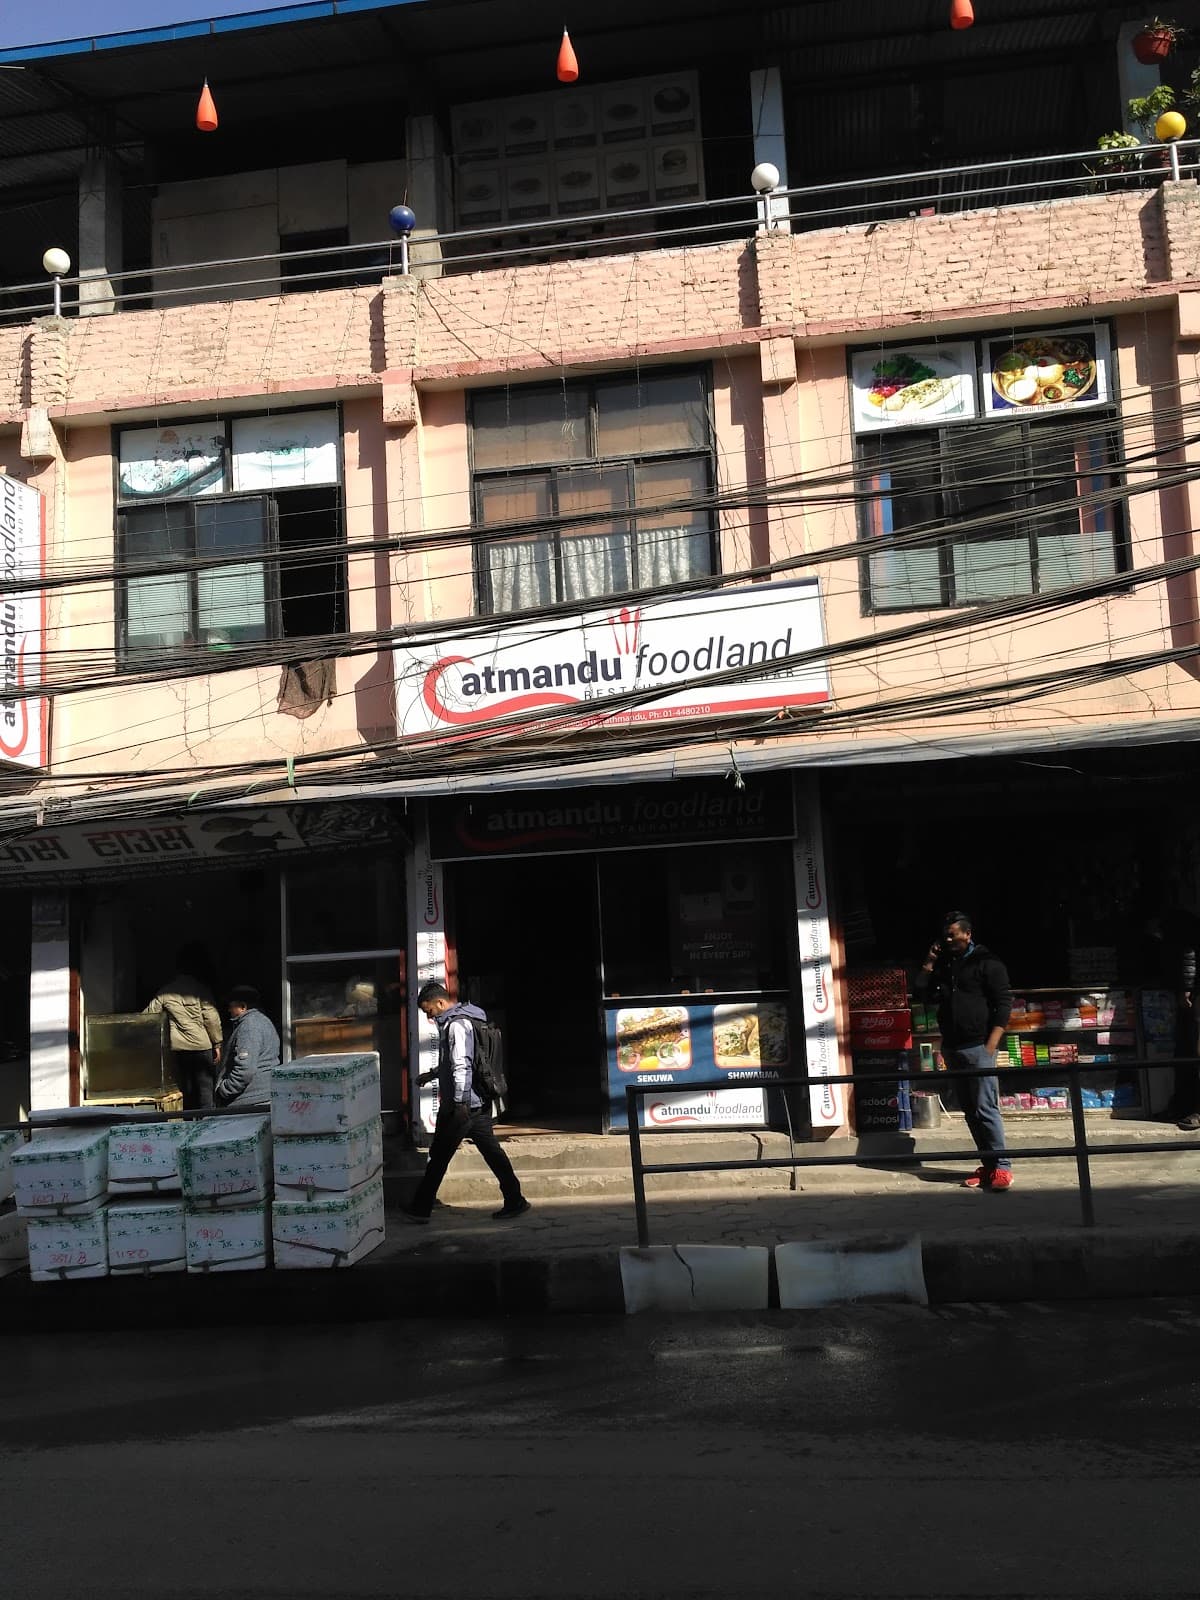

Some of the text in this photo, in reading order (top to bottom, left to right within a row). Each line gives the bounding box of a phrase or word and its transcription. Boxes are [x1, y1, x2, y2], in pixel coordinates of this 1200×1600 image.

[636, 627, 793, 678] foodland
[662, 705, 711, 718] 01-4480210
[632, 788, 766, 823] foodland
[636, 1073, 674, 1083] SEKUWA
[727, 1070, 779, 1081] SHAWARMA
[713, 1102, 763, 1115] foodland
